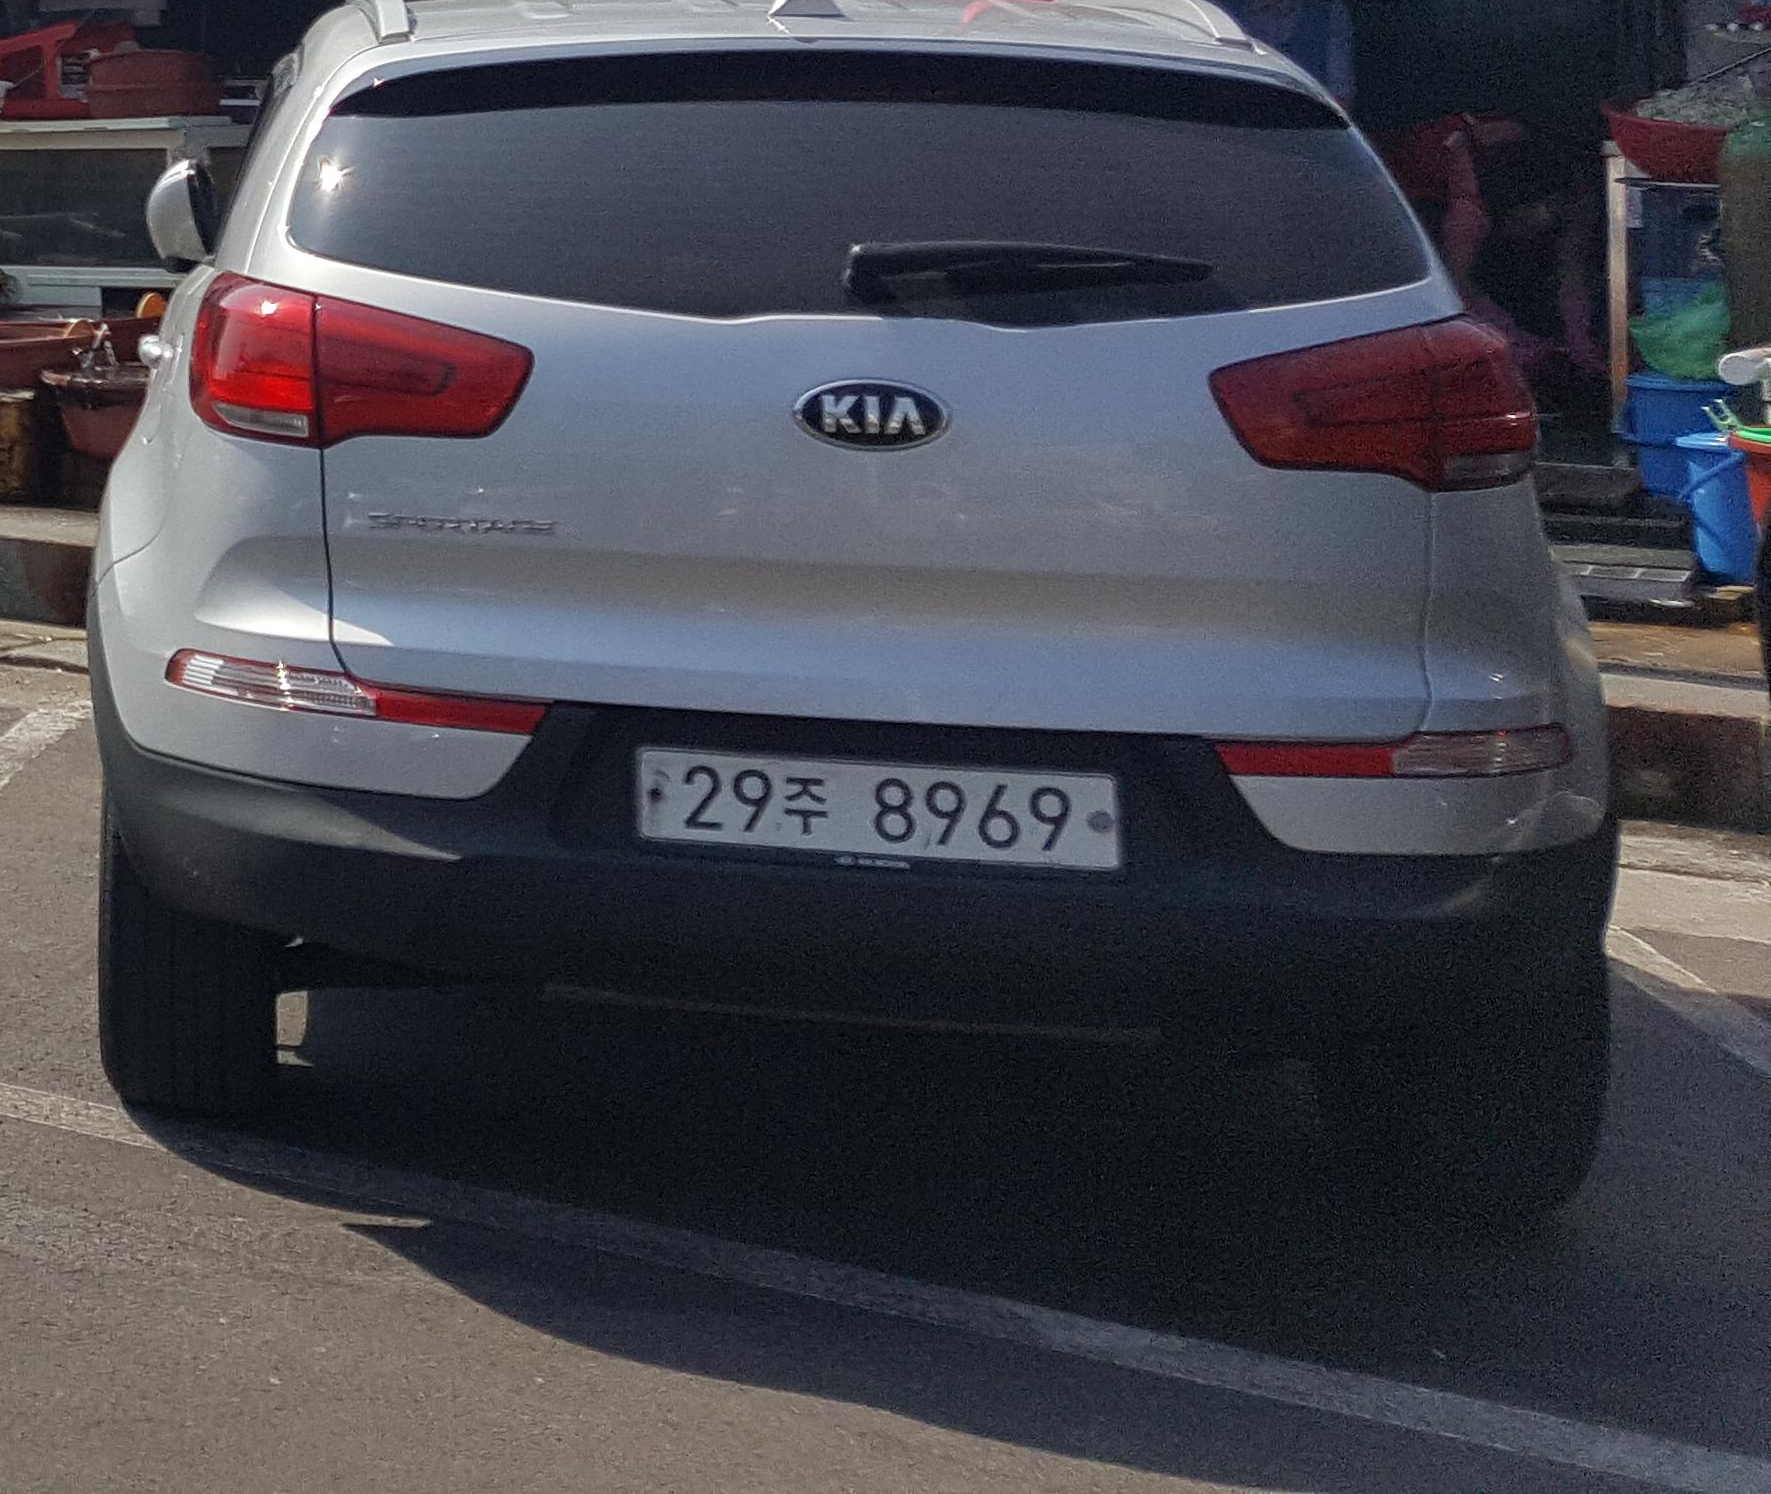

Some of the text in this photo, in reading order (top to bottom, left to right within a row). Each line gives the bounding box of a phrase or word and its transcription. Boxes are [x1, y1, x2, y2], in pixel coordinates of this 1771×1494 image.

[820, 394, 927, 436] KIA
[682, 764, 1073, 853] 29주 8969
